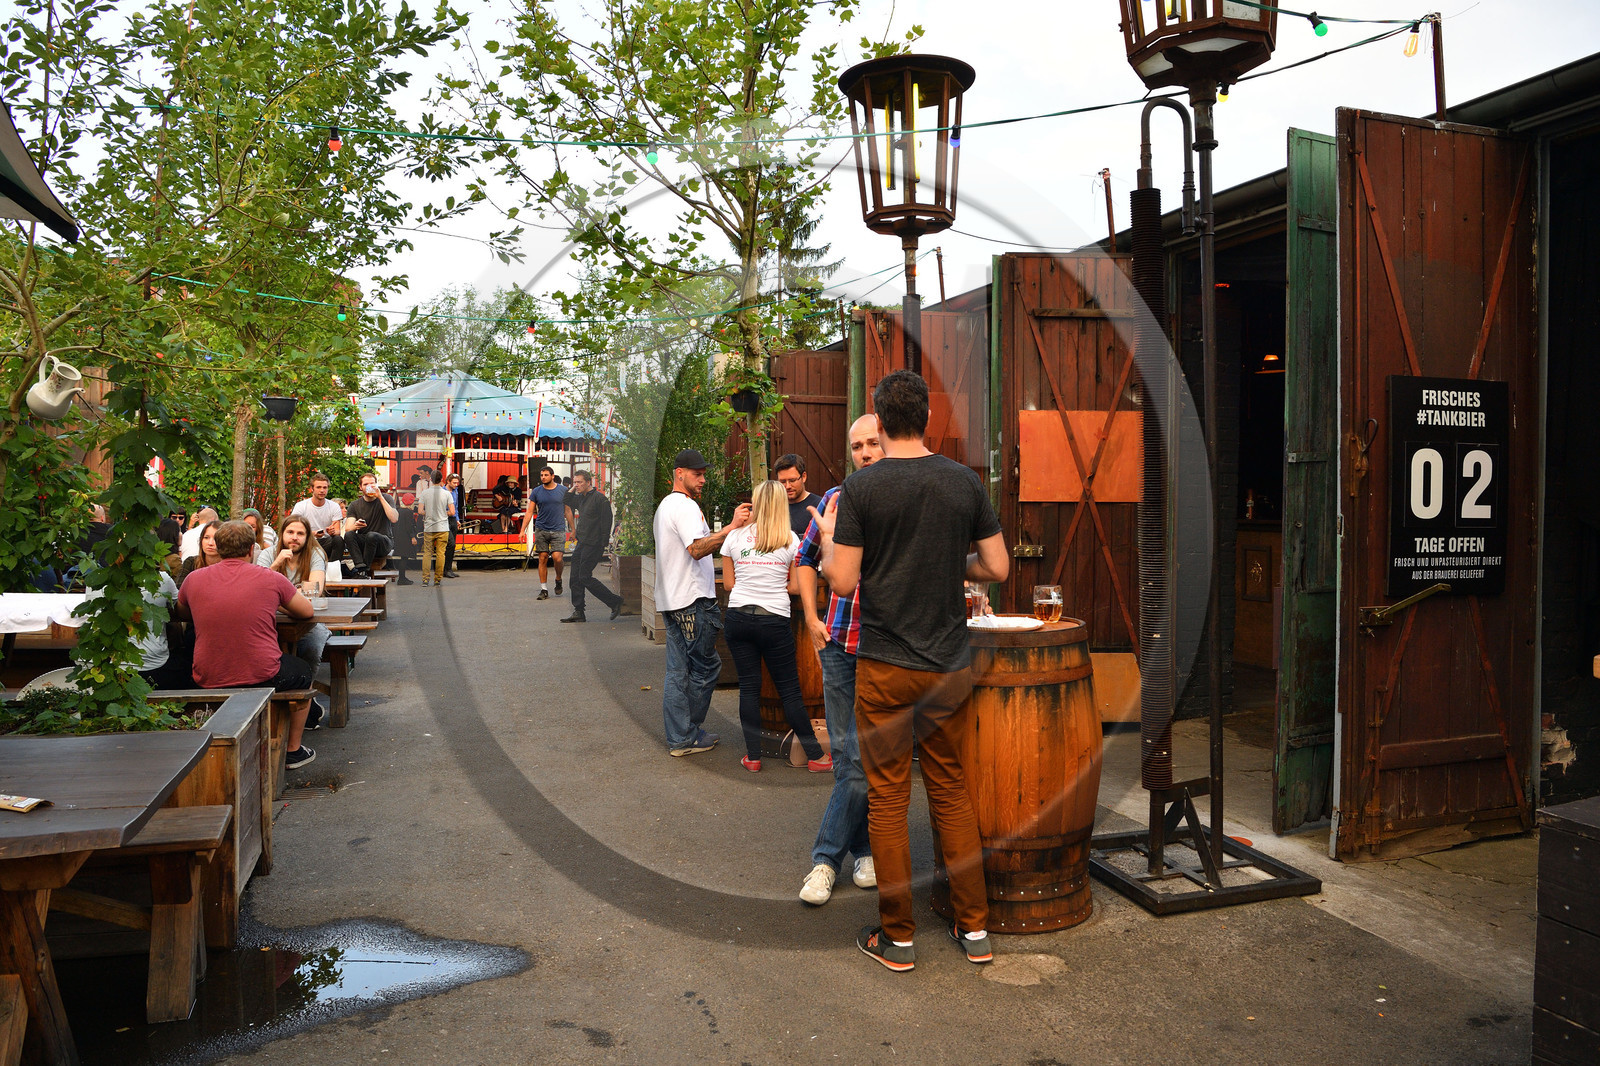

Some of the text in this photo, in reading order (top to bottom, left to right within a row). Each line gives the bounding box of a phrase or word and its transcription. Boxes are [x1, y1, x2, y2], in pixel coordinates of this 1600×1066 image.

[1422, 389, 1481, 408] FRISCHES
[1416, 409, 1486, 427] #TANKBIER
[1414, 537, 1485, 553] TAGE OFFEN
[1394, 556, 1502, 567] FRISCH UND UNPASTEURISIERT DIREKT
[1411, 569, 1485, 580] AUS DER BRAUEREI GELIEFERT
